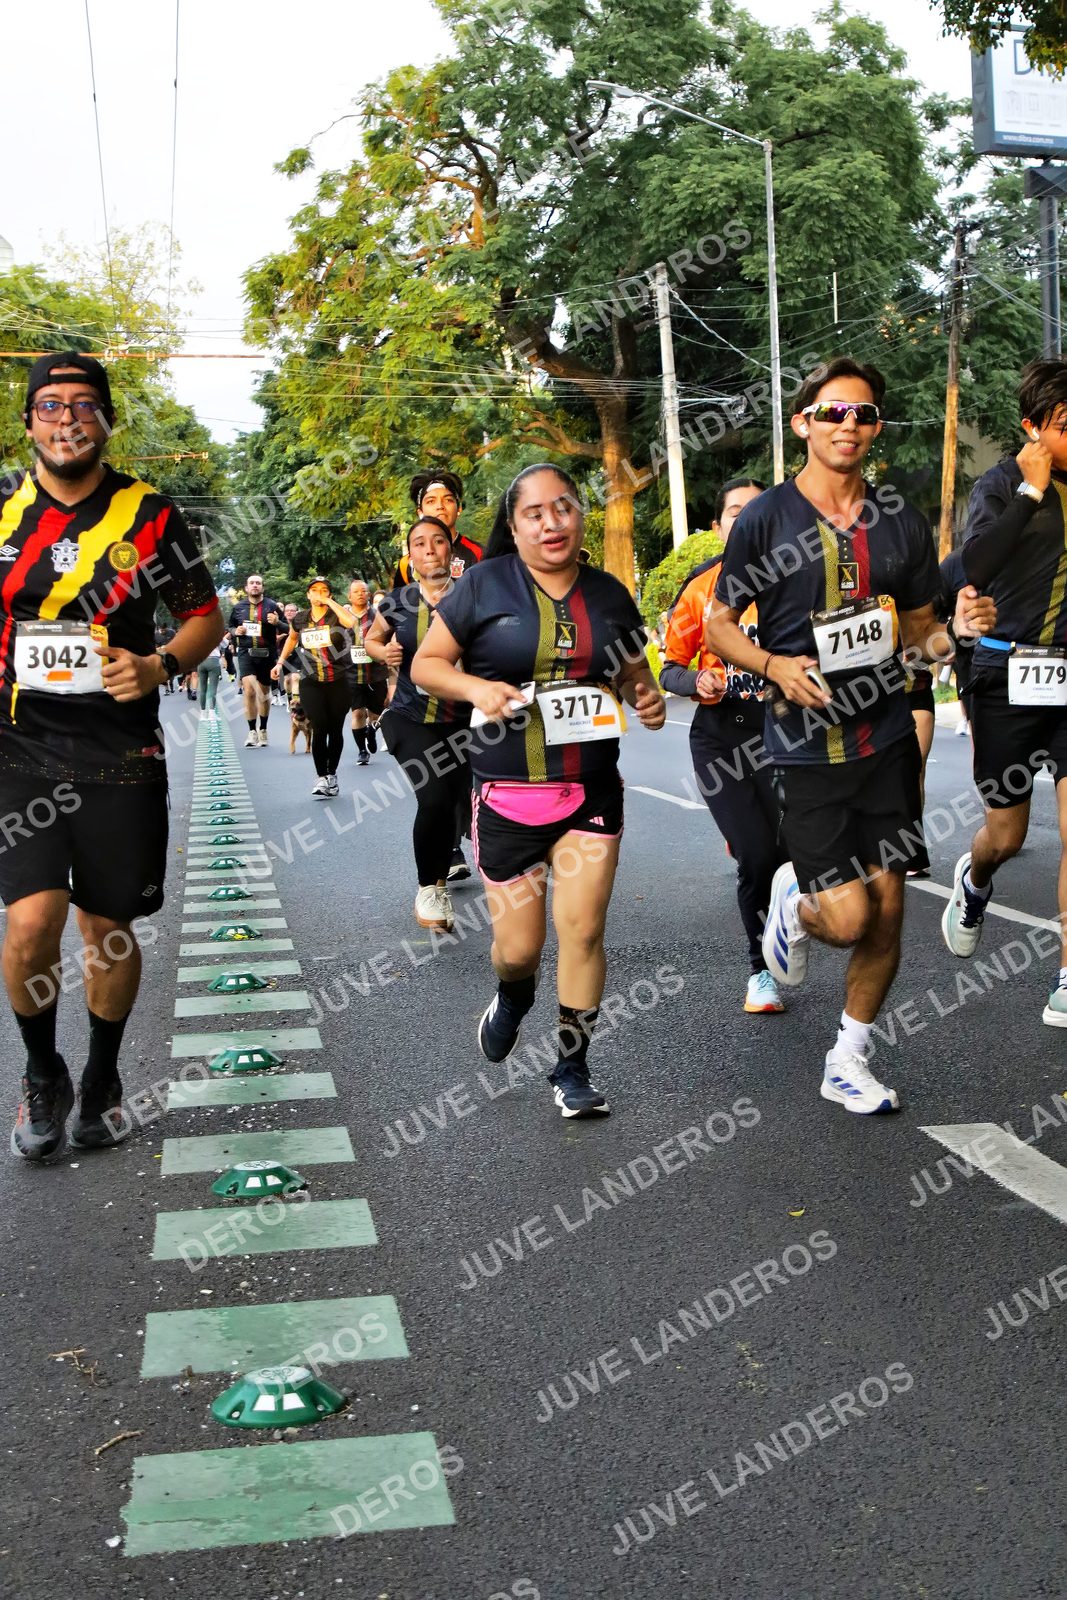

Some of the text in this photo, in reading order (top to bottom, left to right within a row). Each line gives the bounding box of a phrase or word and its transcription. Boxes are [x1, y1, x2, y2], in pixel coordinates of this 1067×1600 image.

[828, 619, 882, 655] 7148
[27, 645, 88, 669] 3042
[1019, 665, 1066, 685] 7179
[551, 694, 603, 720] 3717
